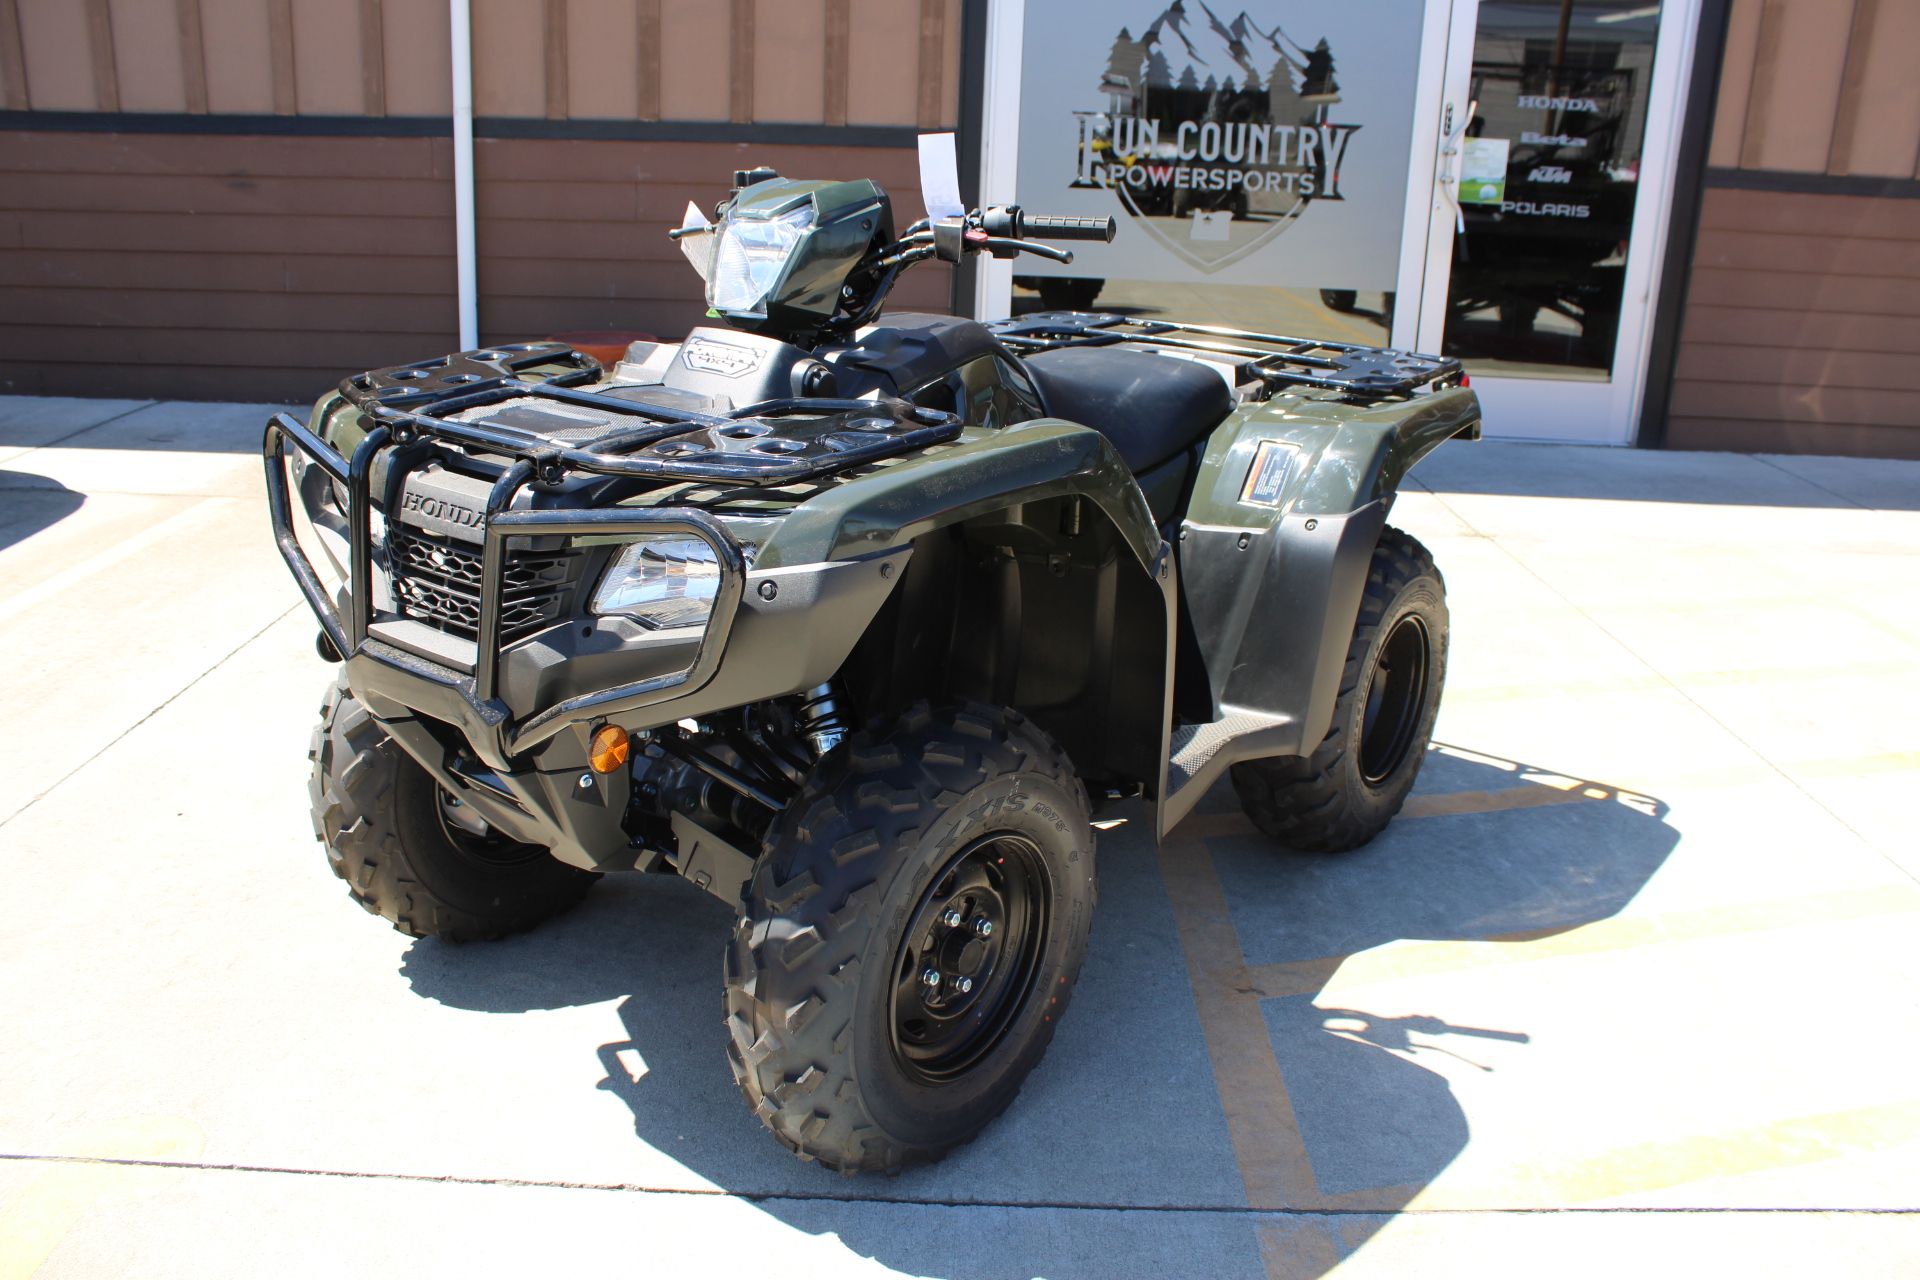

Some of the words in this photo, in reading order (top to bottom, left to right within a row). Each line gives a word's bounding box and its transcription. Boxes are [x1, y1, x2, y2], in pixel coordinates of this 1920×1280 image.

[1517, 95, 1599, 112] HONDA
[1520, 131, 1588, 147] Beta
[1069, 111, 1160, 188] FUN
[1176, 120, 1363, 200] COUNTRY
[1109, 164, 1316, 195] POWERSPORTS
[1527, 166, 1573, 184] KTM
[1501, 201, 1591, 218] POLARIS
[402, 491, 486, 531] HONDA
